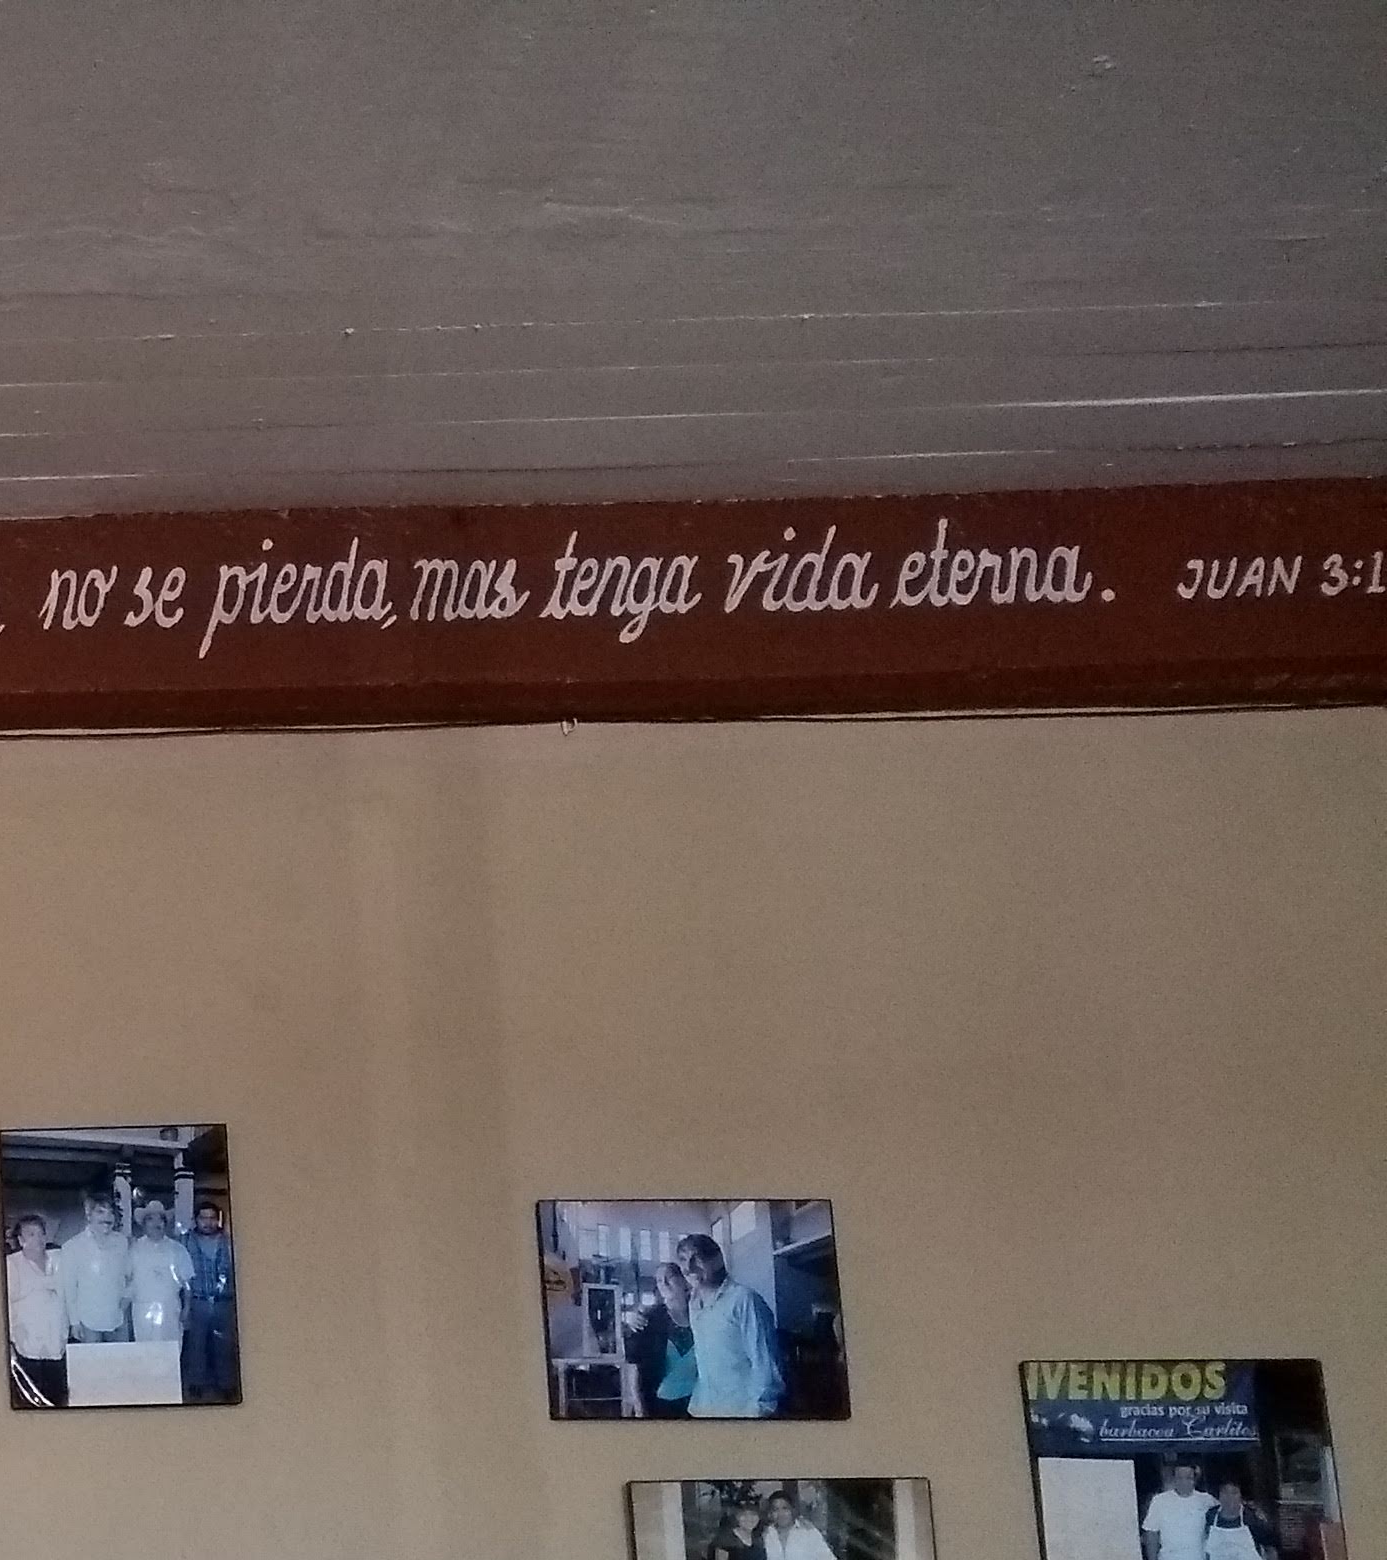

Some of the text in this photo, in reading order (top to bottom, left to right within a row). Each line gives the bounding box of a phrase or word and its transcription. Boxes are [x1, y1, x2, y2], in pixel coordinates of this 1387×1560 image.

[37, 564, 119, 631] no
[123, 565, 187, 629] se
[198, 536, 398, 660] pierda,
[409, 557, 531, 622] mas
[538, 530, 703, 644] tenga
[723, 524, 880, 614] vida
[888, 517, 1116, 609] eterna.
[1176, 555, 1304, 601] JUAN
[1119, 1403, 1165, 1418] gracias
[1168, 1405, 1191, 1418] por
[1214, 1402, 1248, 1416] visita
